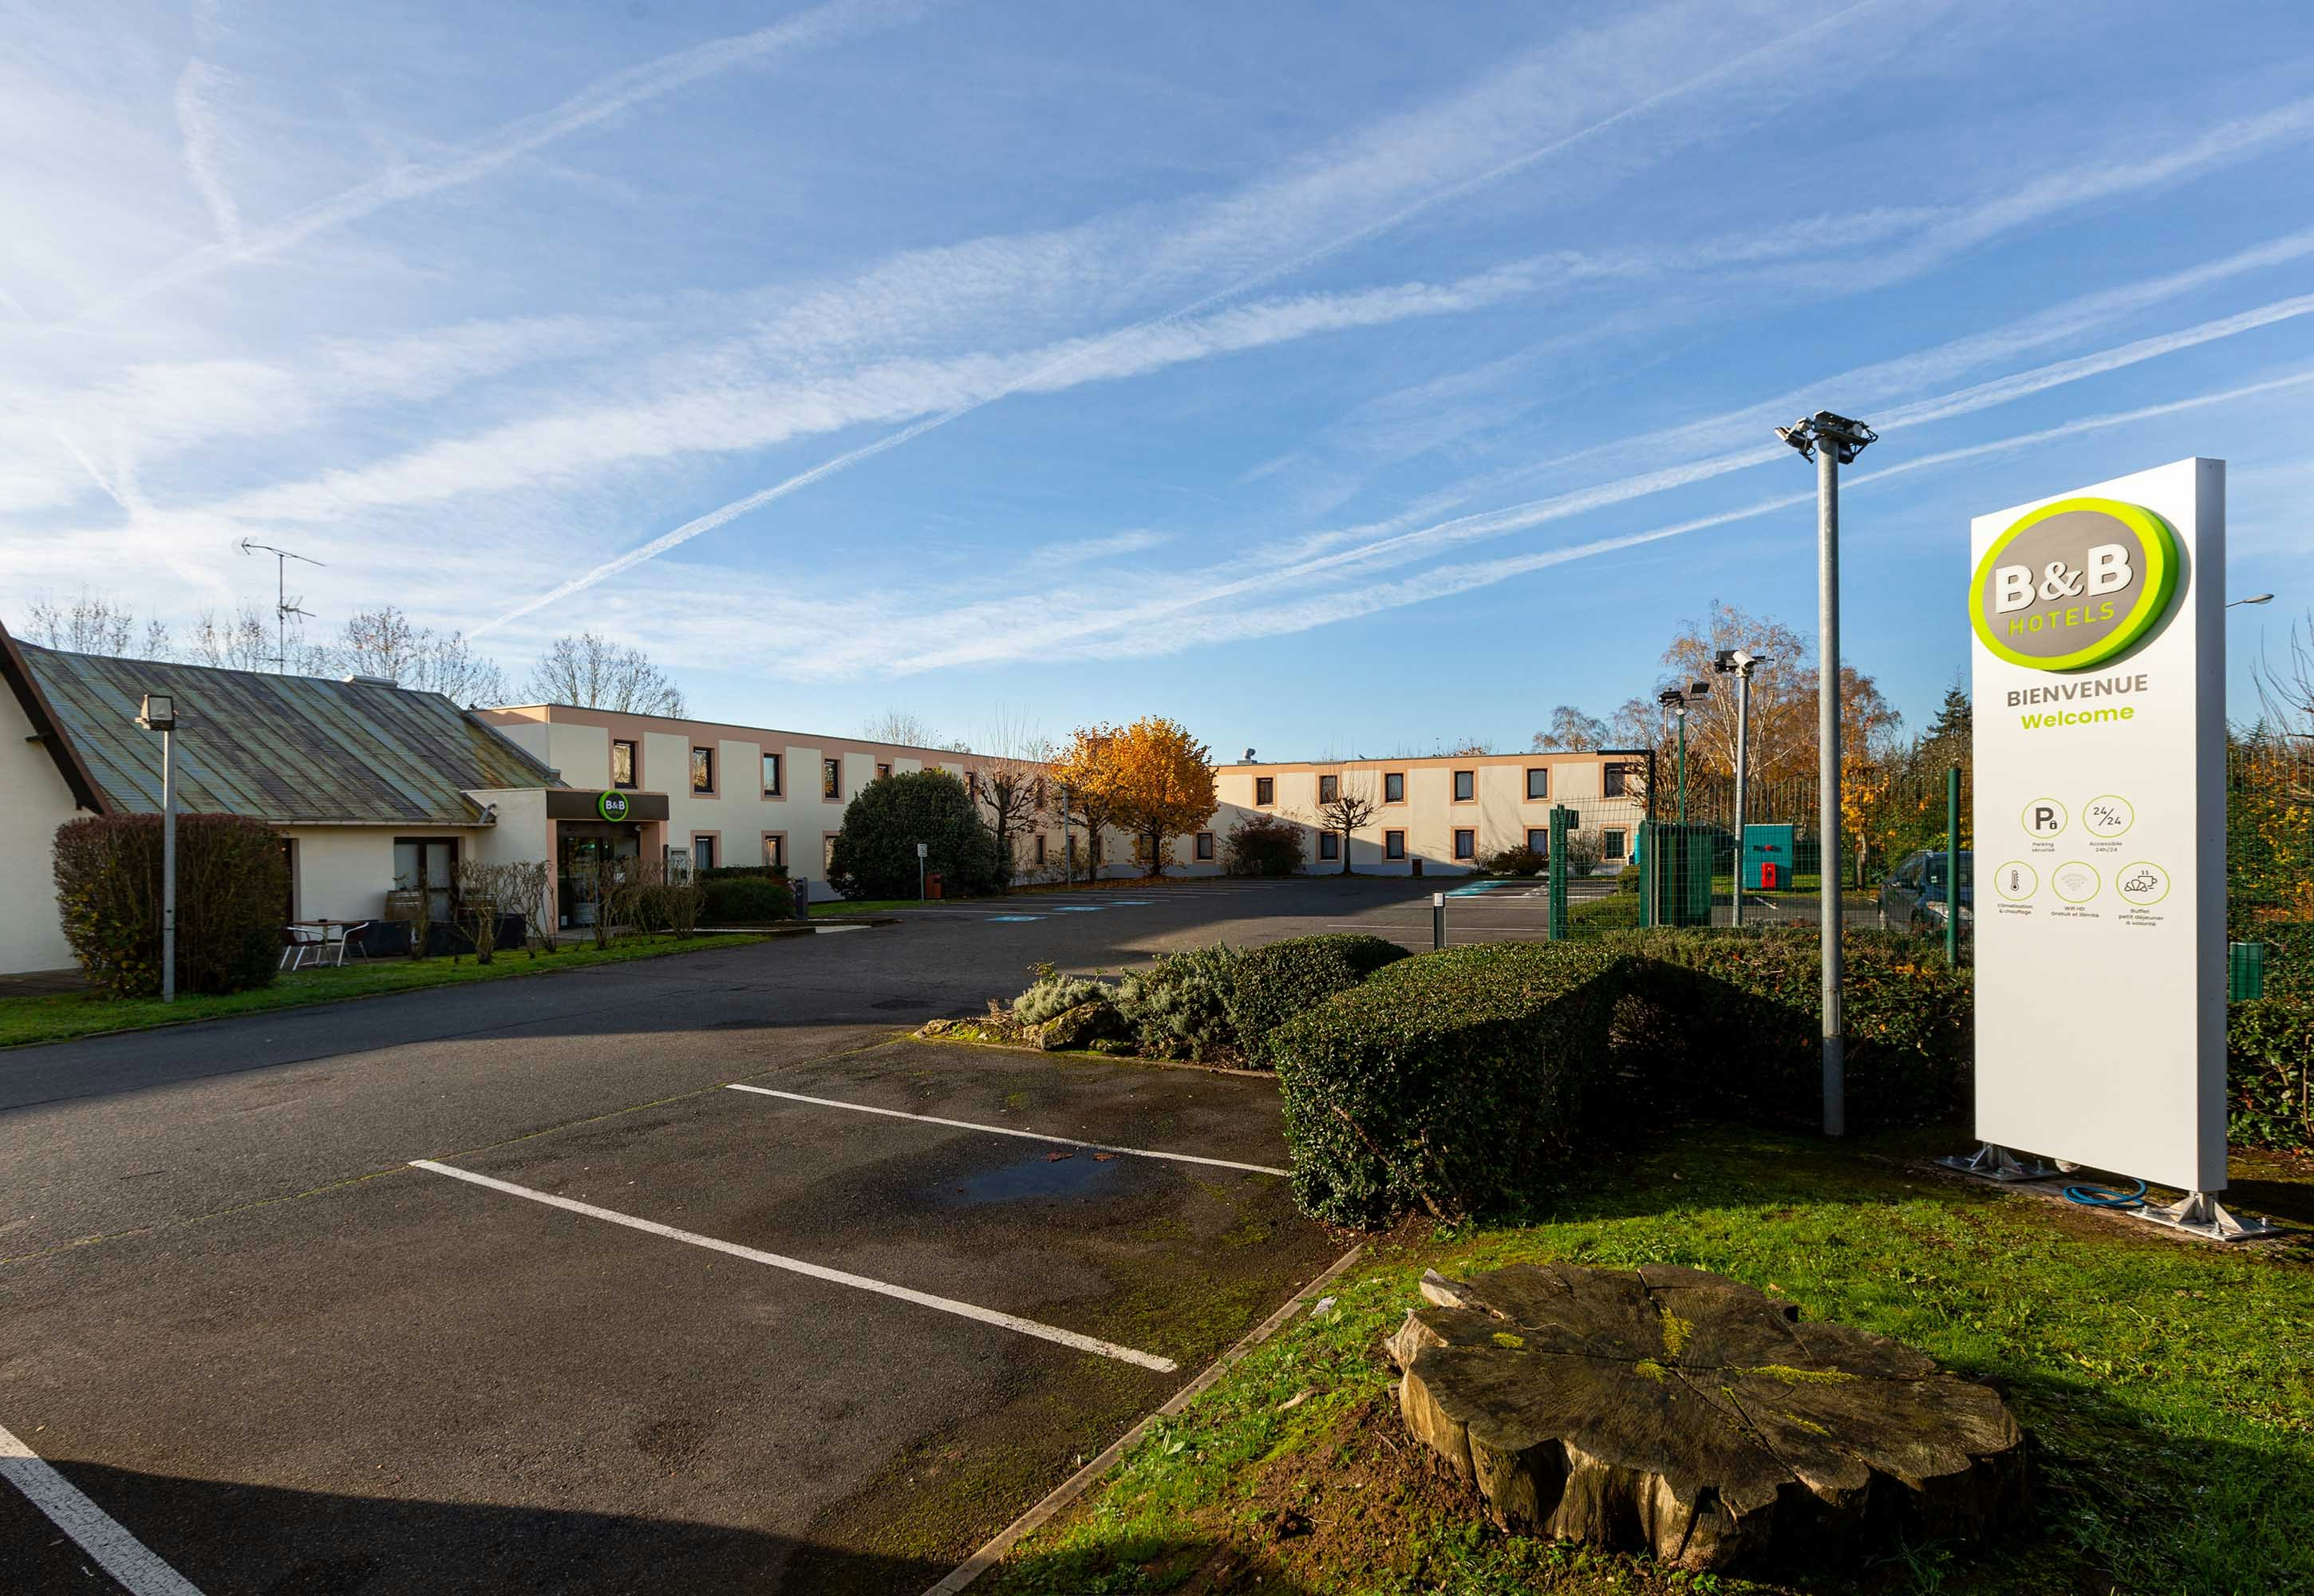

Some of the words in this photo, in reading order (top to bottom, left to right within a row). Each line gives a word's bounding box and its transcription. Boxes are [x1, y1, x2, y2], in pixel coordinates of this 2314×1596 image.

[1996, 543, 2133, 614] B&B
[2008, 602, 2114, 636] HOTELS
[2007, 674, 2148, 707] BIENVENUE
[2021, 706, 2134, 729] Welcome
[606, 800, 626, 810] B&B
[2036, 807, 2055, 830] P
